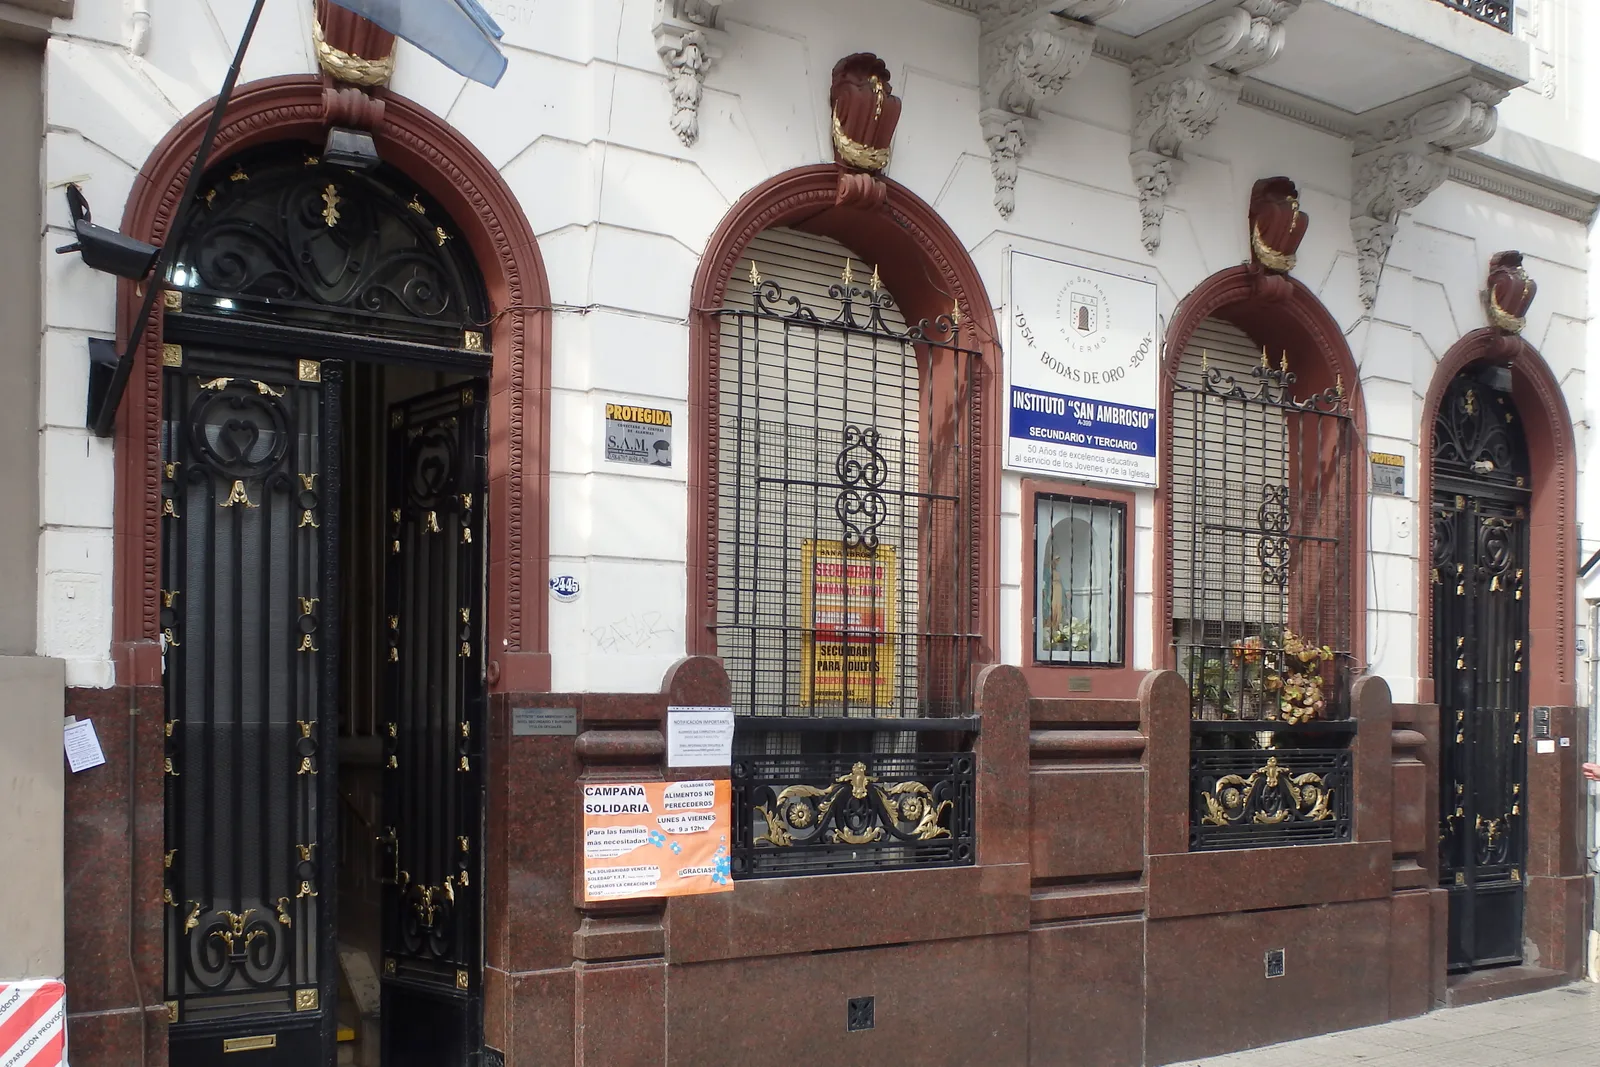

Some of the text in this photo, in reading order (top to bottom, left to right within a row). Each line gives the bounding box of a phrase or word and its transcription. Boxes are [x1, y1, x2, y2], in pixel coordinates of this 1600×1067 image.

[1077, 276, 1092, 284] San
[1060, 328, 1107, 353] PALERMO
[1040, 351, 1080, 383] BODAS
[1083, 371, 1100, 384] DE
[1102, 366, 1125, 383] ORO
[1013, 390, 1065, 416] INSTITUTO
[606, 404, 672, 426] PROTEGIDA
[608, 435, 649, 452] S.A.M.
[1029, 426, 1137, 450] SECUNDARIO Y TERCIARIO
[1027, 444, 1139, 467] 50 Años de excelencia educativa
[1015, 454, 1150, 480] al servicio de los Jovenes y de la Iglesia
[816, 563, 883, 580] SECUNDARO
[552, 577, 579, 592] 2445
[817, 661, 880, 672] PARA DULTS
[585, 786, 645, 796] CAMPAÑA
[585, 804, 650, 813] SOLIDARIA
[586, 829, 609, 837] ¡Para
[587, 838, 602, 846] más
[3, 1002, 65, 1067] EPARACION PROVISO
